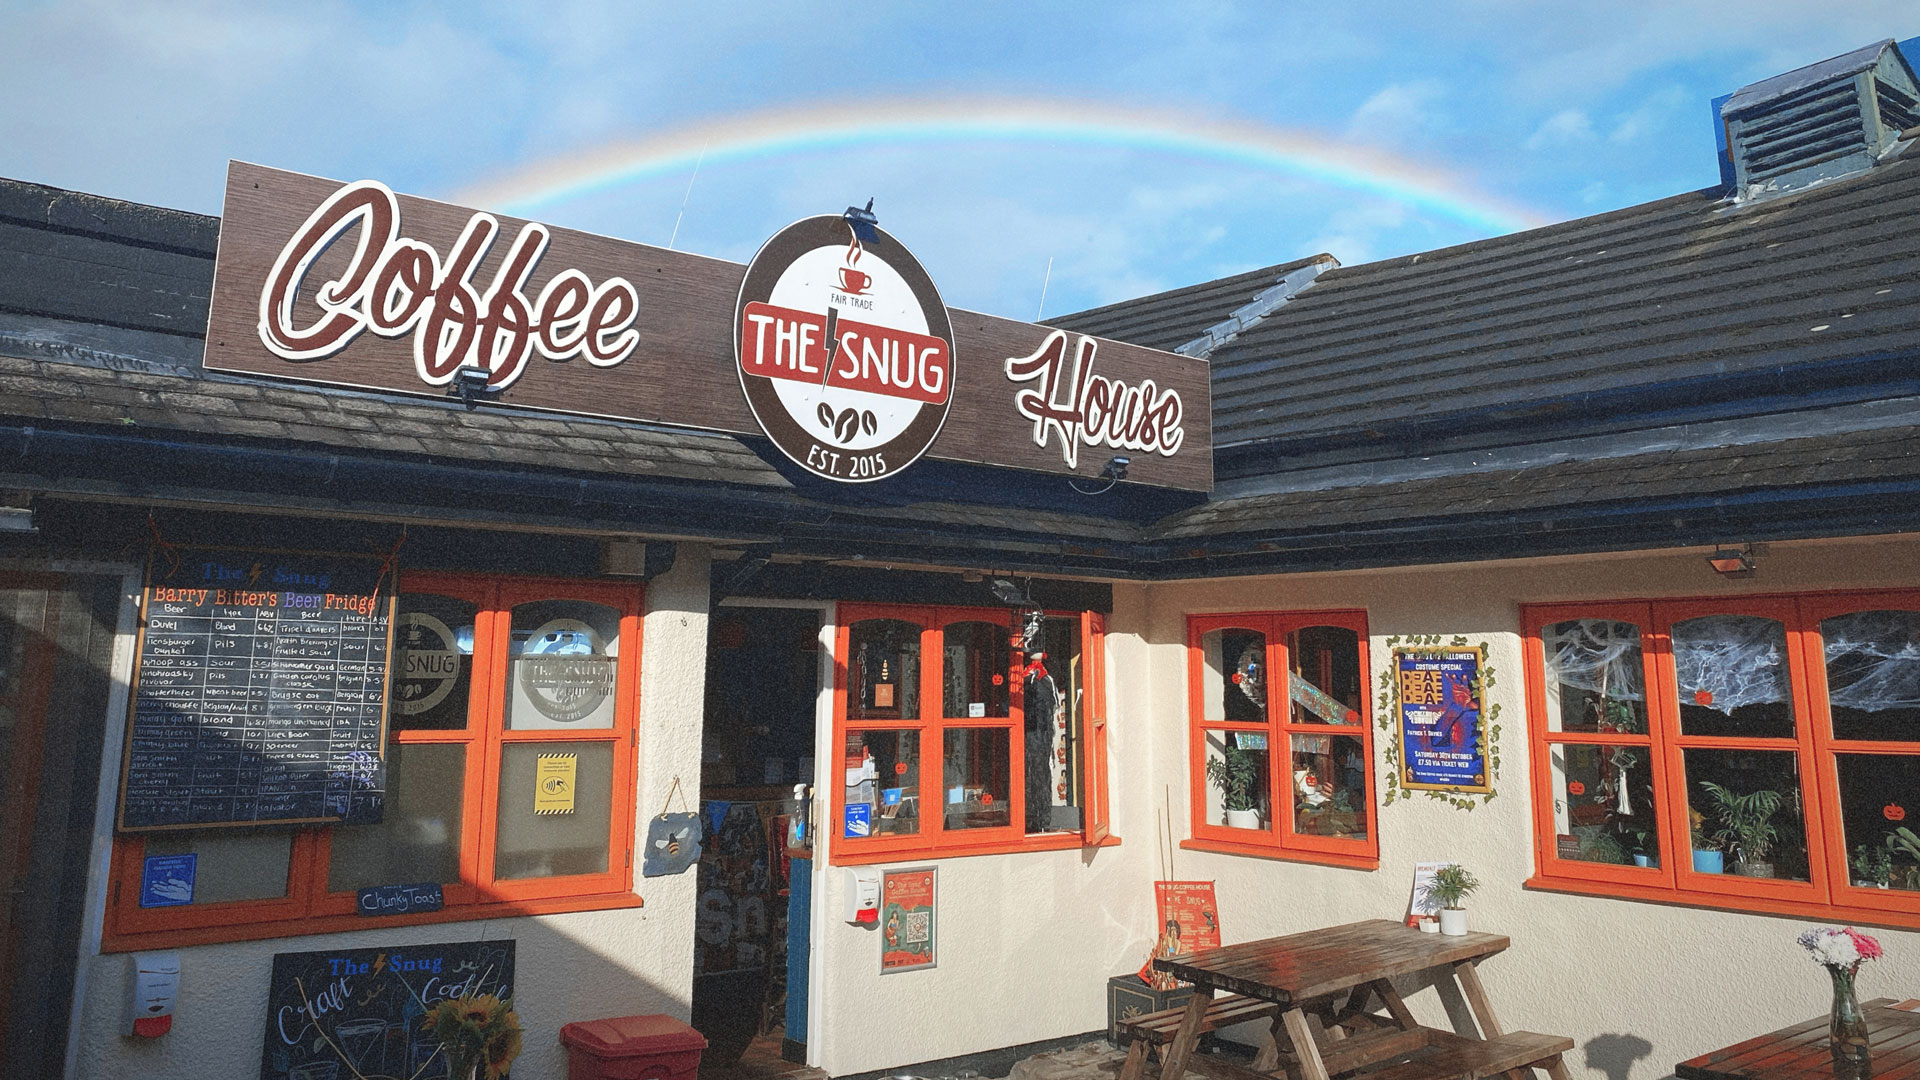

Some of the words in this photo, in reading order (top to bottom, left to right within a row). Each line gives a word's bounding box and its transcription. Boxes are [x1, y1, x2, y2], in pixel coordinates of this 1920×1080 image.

[258, 179, 639, 388] Coffee
[830, 293, 849, 306] FAIR
[850, 296, 874, 311] TRADE
[747, 313, 819, 373] THE
[838, 330, 945, 394] SNUG
[1005, 330, 1184, 469] House
[806, 444, 842, 476] EST.
[848, 452, 887, 478] 2015
[203, 562, 242, 580] The
[273, 568, 329, 589] Snug
[153, 585, 208, 607] Barry
[215, 588, 277, 607] Bitter's
[284, 592, 321, 609] Beer
[324, 594, 377, 615] Fridge
[164, 603, 187, 613] Beer
[259, 610, 275, 618] ABV
[301, 611, 322, 620] Beer
[151, 619, 178, 631] Duvel
[406, 654, 455, 674] SNUG
[1415, 663, 1440, 671] COSTUME
[1441, 663, 1463, 671] SPECIAL
[362, 892, 408, 911] Chunky
[402, 888, 441, 905] Toast
[328, 958, 369, 977] The
[390, 954, 443, 975] Snug
[279, 975, 355, 1045] Craft
